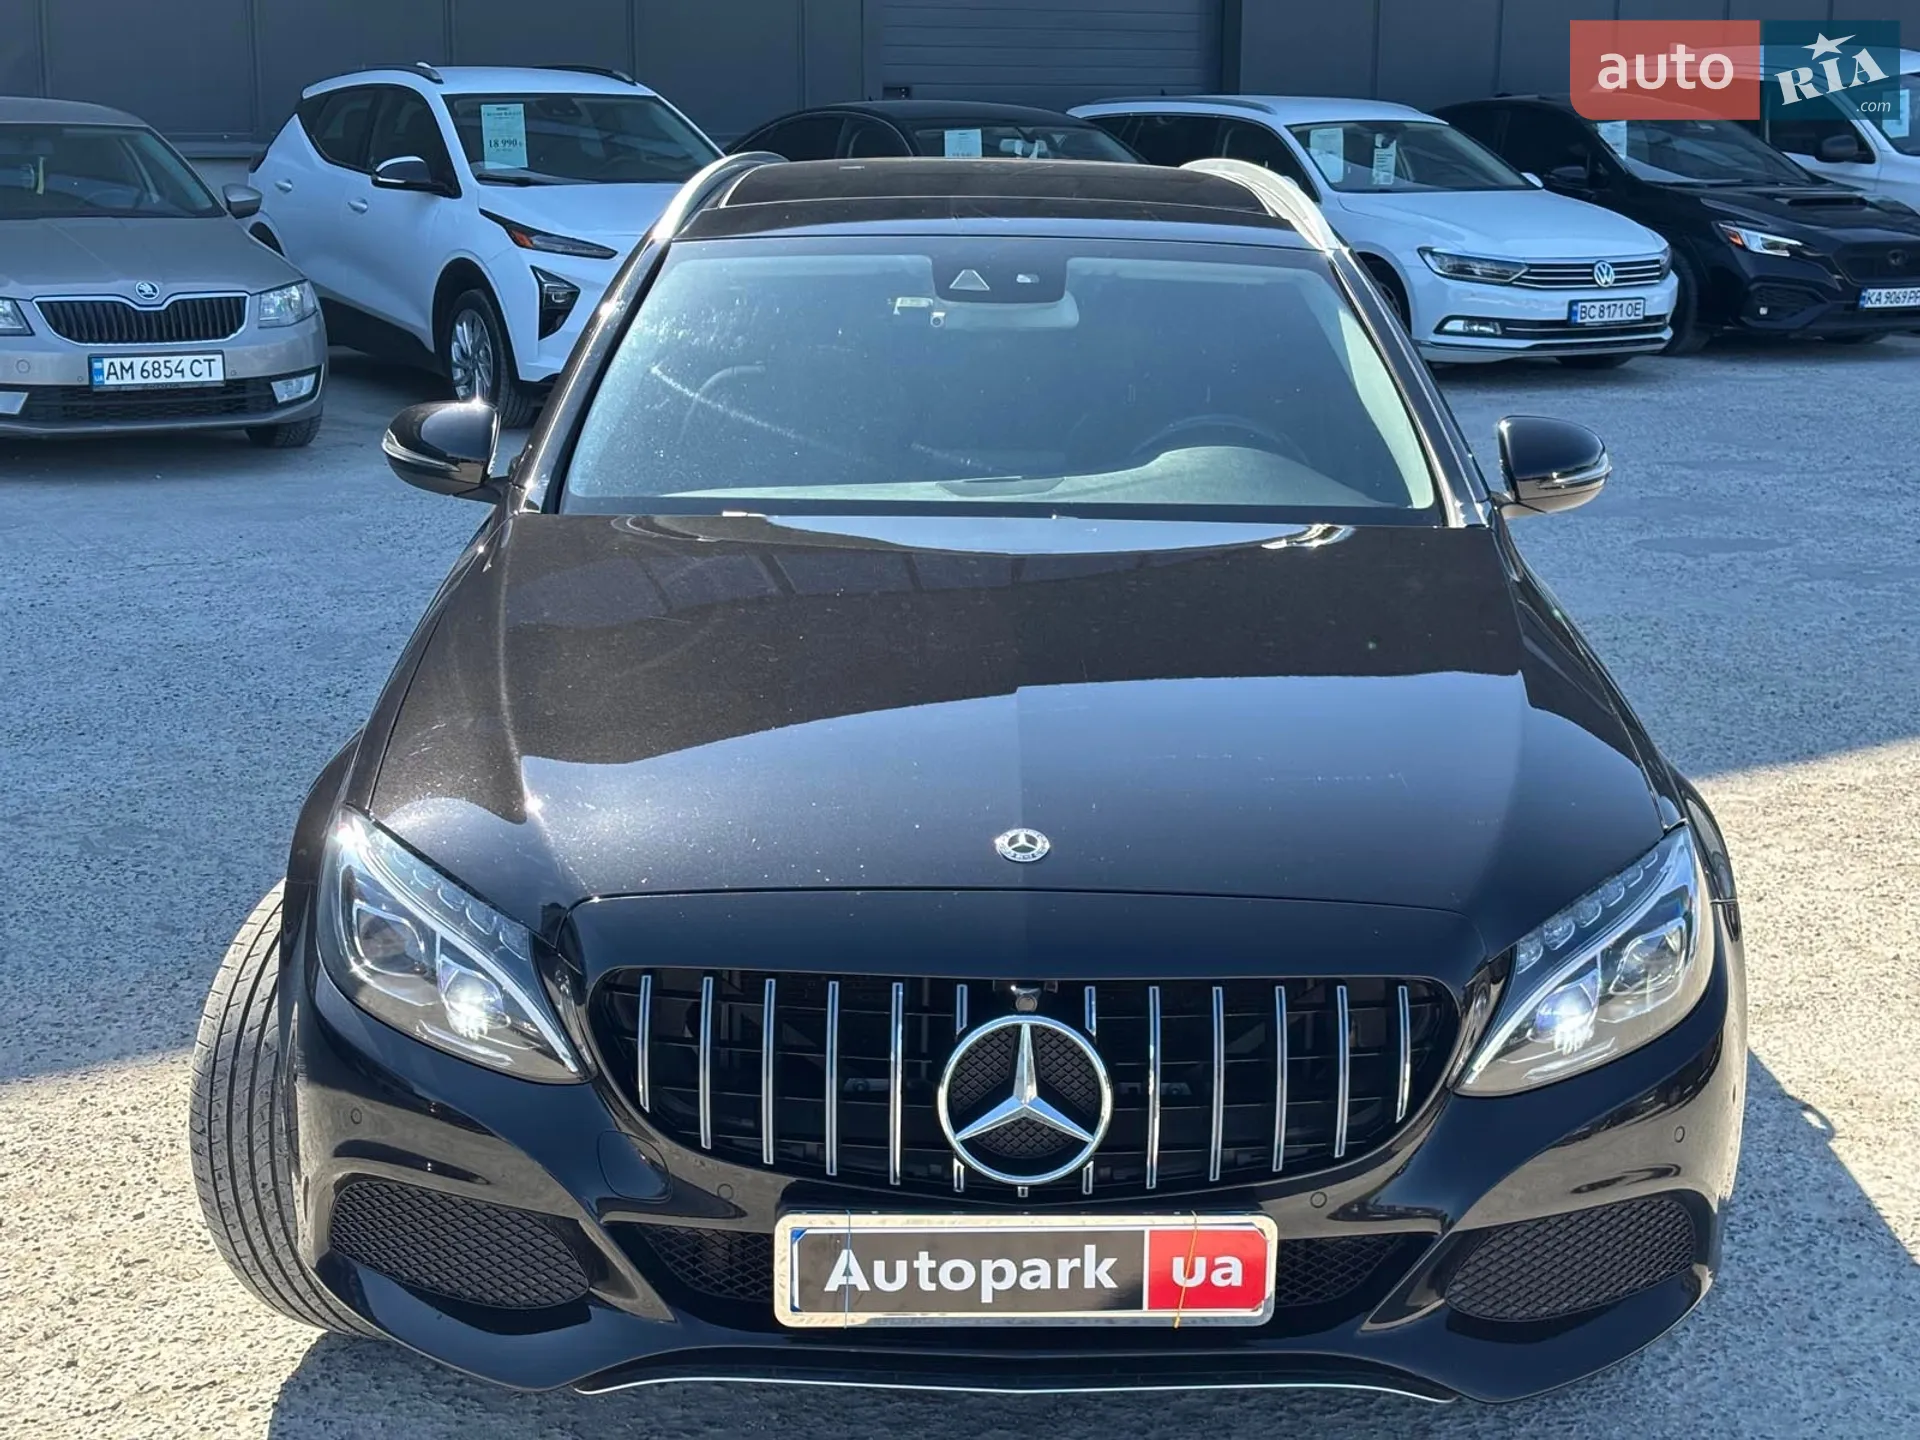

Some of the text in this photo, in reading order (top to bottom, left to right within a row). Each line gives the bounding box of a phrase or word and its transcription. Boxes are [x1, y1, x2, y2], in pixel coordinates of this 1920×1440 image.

[1580, 304, 1597, 320] BC
[1598, 303, 1624, 319] 8171
[1626, 302, 1642, 318] OE
[105, 358, 216, 381] AM 6854 CT
[824, 1244, 1243, 1303] Autopark ua
